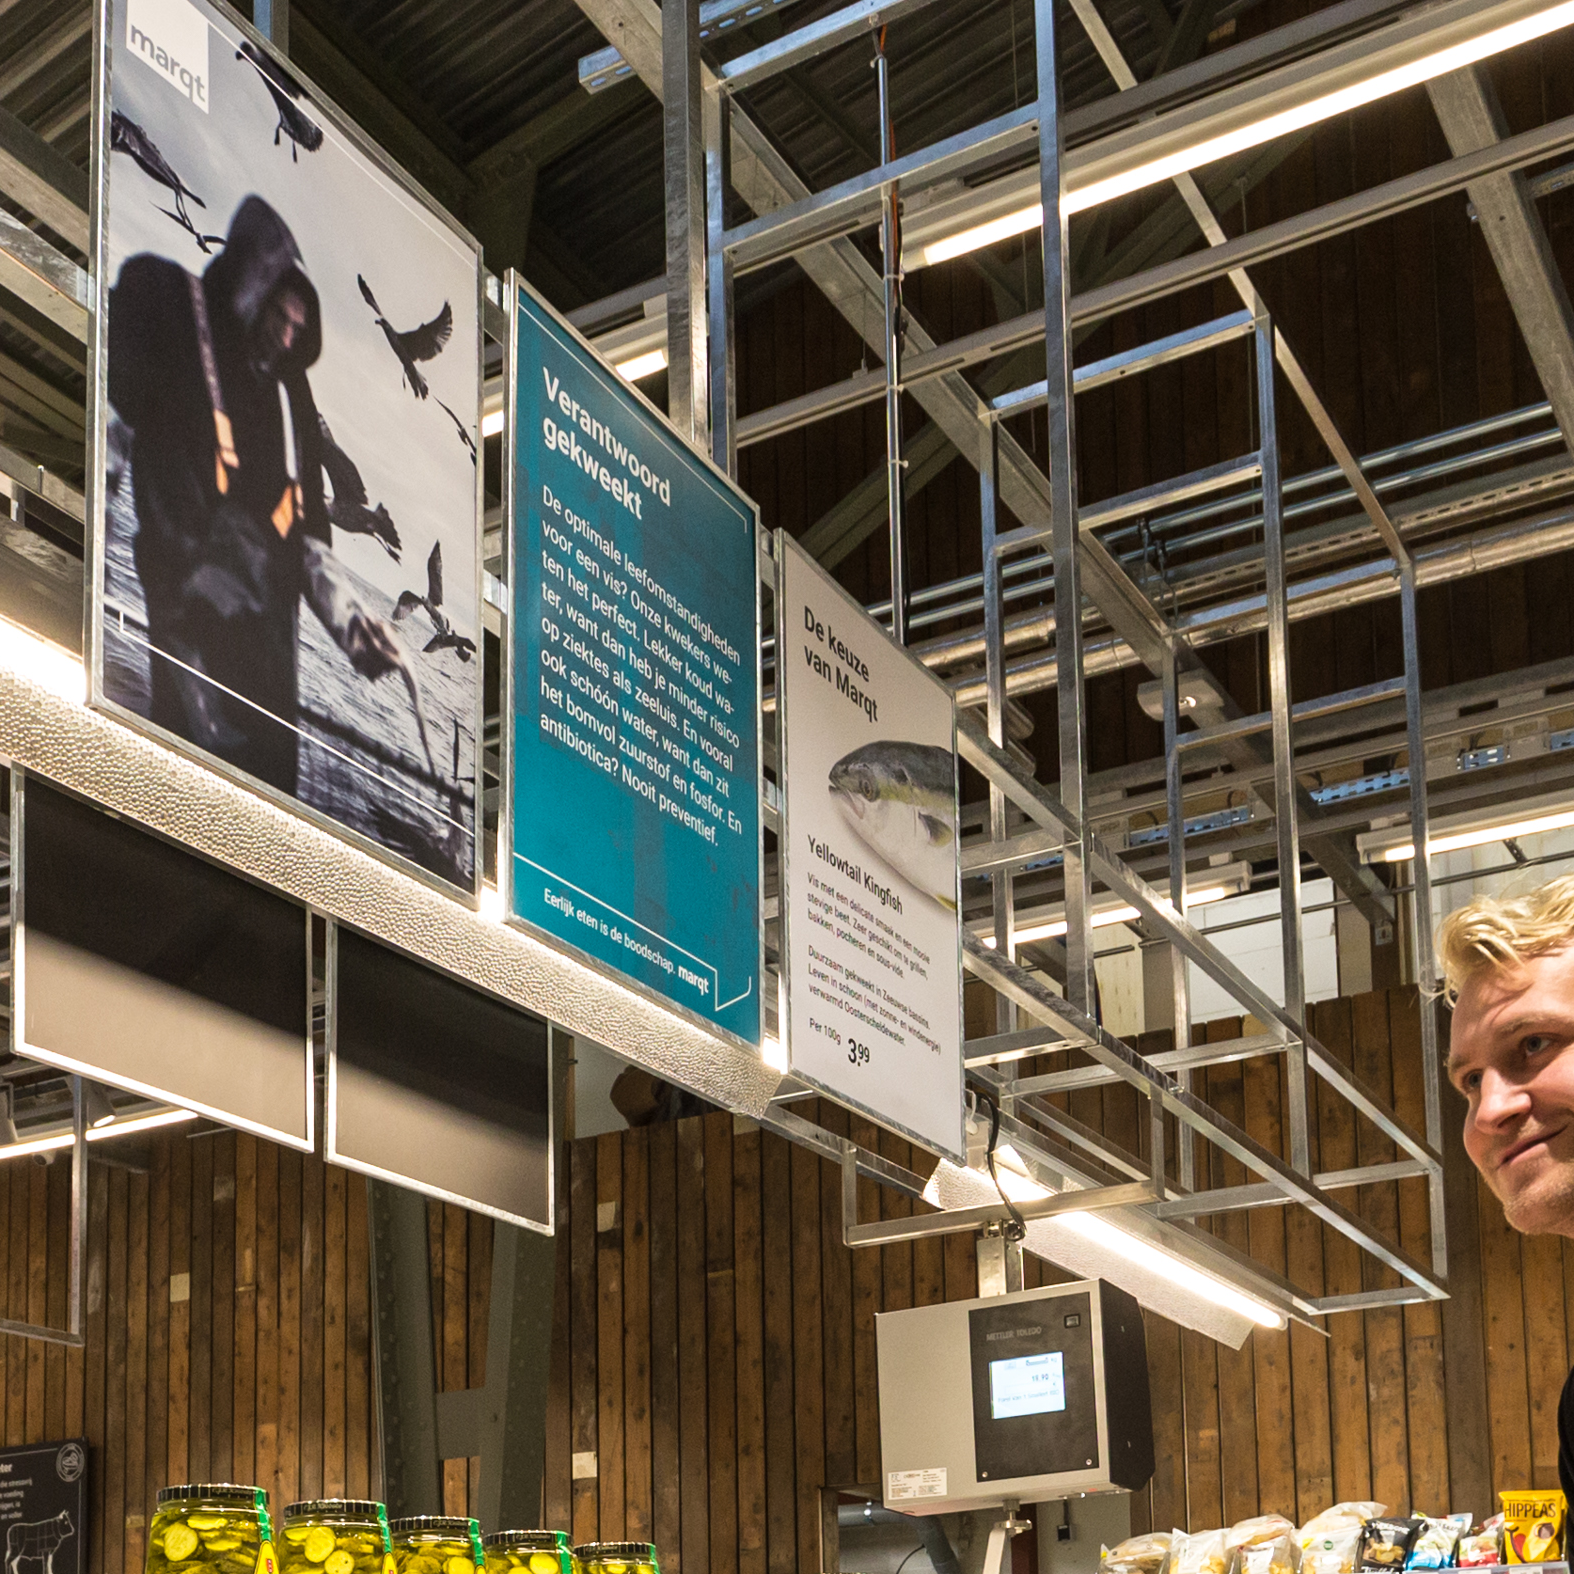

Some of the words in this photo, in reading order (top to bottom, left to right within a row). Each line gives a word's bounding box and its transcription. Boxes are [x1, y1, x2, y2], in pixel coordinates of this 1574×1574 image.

[130, 25, 206, 104] marqt
[543, 366, 670, 507] Verantwoord
[543, 417, 642, 520] gekweekt
[542, 519, 573, 555] voor
[576, 549, 600, 578] een
[603, 569, 627, 599] vis?
[631, 590, 661, 628] Onze
[665, 616, 711, 669] kwekers
[713, 665, 732, 685] we-
[543, 485, 561, 516] De
[564, 508, 621, 565] optimale
[625, 553, 741, 667] leefomstandigheden
[542, 549, 563, 582] ten
[568, 567, 588, 602] het
[592, 592, 640, 642] perfect.
[644, 630, 683, 674] Lekker
[686, 668, 713, 700] koud
[715, 696, 734, 716] wa-
[542, 582, 563, 615] ter,
[567, 605, 598, 641] want
[601, 630, 626, 660] dan
[629, 647, 652, 680] heb
[655, 667, 666, 690] je
[669, 681, 708, 723] minder
[709, 713, 740, 749] risico
[804, 605, 824, 642] De
[828, 625, 870, 683] keuze
[542, 616, 559, 642] op
[563, 631, 609, 679] ziektes
[612, 670, 632, 695] als
[635, 685, 680, 731] zeeluis.
[683, 718, 697, 745] En
[700, 737, 734, 772] vooral
[804, 645, 831, 683] van
[836, 666, 878, 723] Marqt
[541, 675, 563, 709] het
[567, 694, 615, 745] bomvol
[618, 736, 670, 783] zuurstof
[673, 774, 687, 794] en
[690, 780, 725, 823] fosfor.
[728, 810, 742, 835] En
[542, 650, 567, 682] ook
[570, 668, 619, 717] schóón
[621, 707, 660, 748] water,
[662, 735, 690, 772] want
[693, 755, 714, 786] dan
[715, 775, 730, 799] zit
[540, 712, 619, 776] antibiotica?
[622, 765, 656, 804] Nooit
[659, 791, 719, 847] preventief.
[807, 892, 833, 915] stevige
[853, 917, 867, 935] Zeer
[808, 834, 861, 884] Yellowtail
[864, 872, 903, 915] Kingfish
[808, 872, 819, 888] Vis
[820, 882, 834, 898] met
[836, 891, 848, 906] een
[849, 899, 874, 923] delicate
[544, 888, 574, 918] Eerlijk
[576, 908, 598, 931] eten
[600, 920, 609, 936] is
[610, 923, 622, 943] de
[624, 931, 676, 976] boodschap.
[678, 964, 709, 994] marqt
[808, 908, 835, 935] bakken,
[836, 927, 866, 953] pocheren
[808, 944, 843, 975] Duurzaam
[845, 967, 875, 994] gekweekt
[808, 962, 829, 986] Leven
[831, 975, 837, 989] in
[839, 980, 862, 1003] schoon
[864, 994, 878, 1013] (met
[808, 983, 843, 1010] verwarmd
[809, 1017, 822, 1034] Per
[824, 1025, 842, 1046] 100g
[986, 1329, 1014, 1341] METTLER
[1016, 1326, 1042, 1337] TOLEDO
[1504, 1502, 1556, 1519] HIPPEAS
